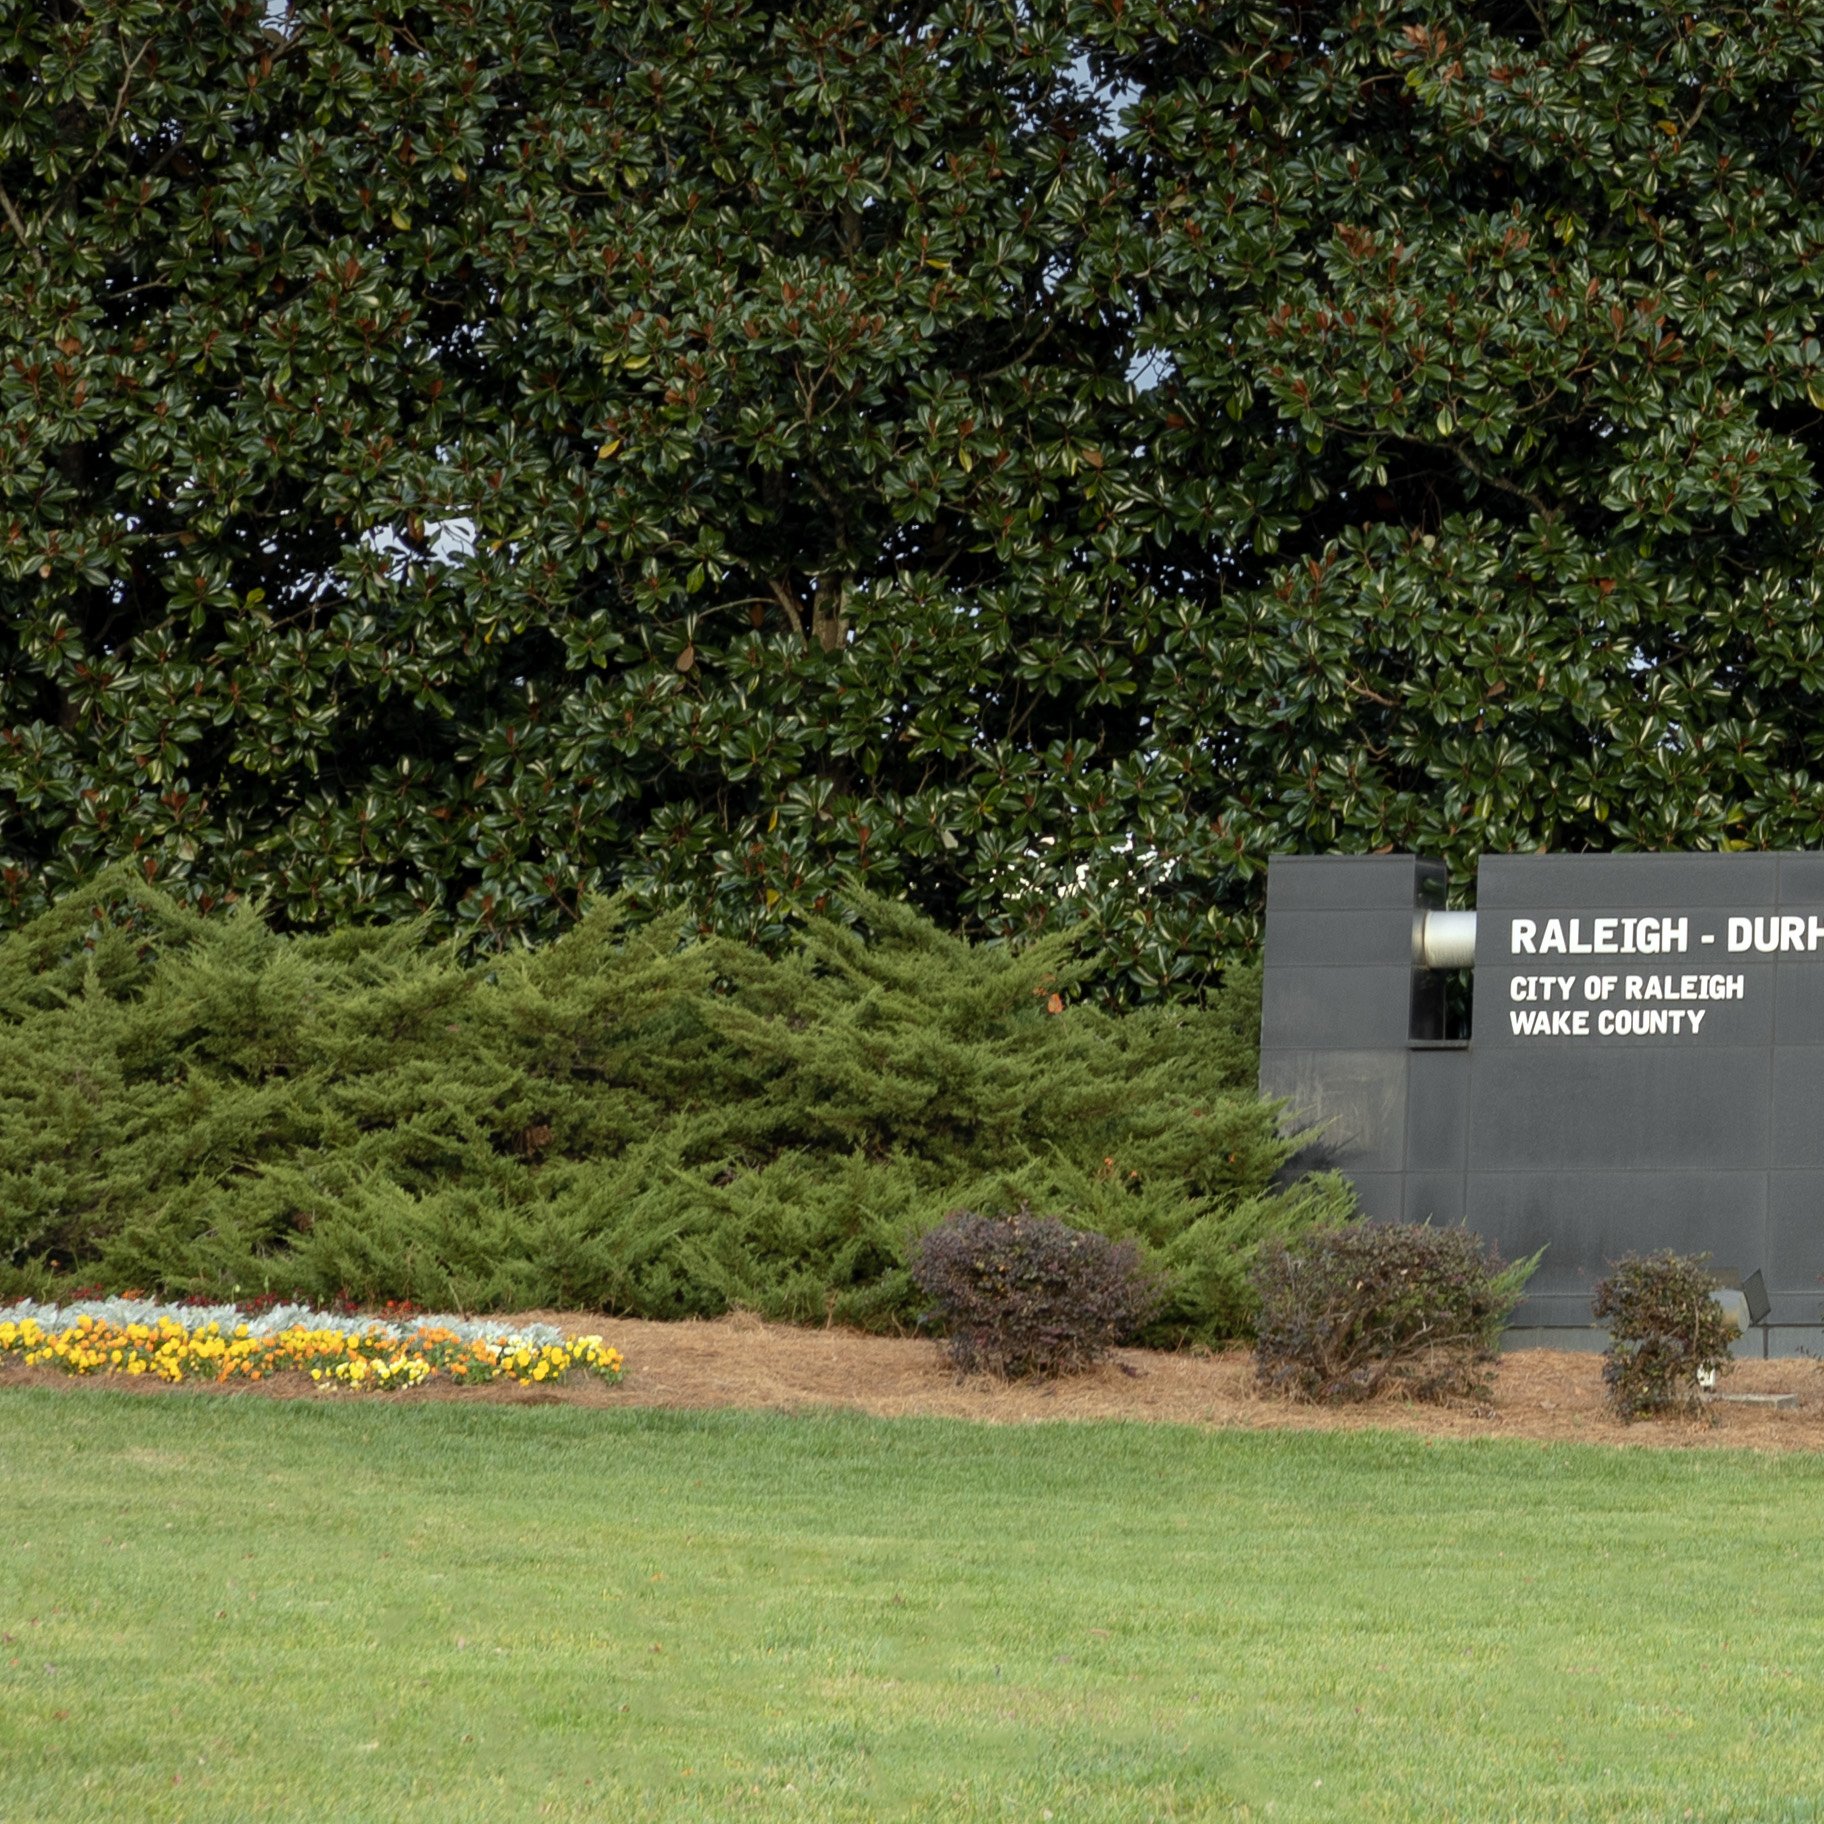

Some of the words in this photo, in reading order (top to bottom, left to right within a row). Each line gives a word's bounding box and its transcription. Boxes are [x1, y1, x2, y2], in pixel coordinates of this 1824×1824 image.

[1510, 916, 1689, 955] RALEIGH
[1509, 974, 1577, 1003] CITY
[1583, 974, 1619, 1002] OF
[1624, 973, 1746, 1001] RALEIGH
[1508, 1009, 1591, 1037] WAKE
[1597, 1008, 1707, 1037] COUNTY
